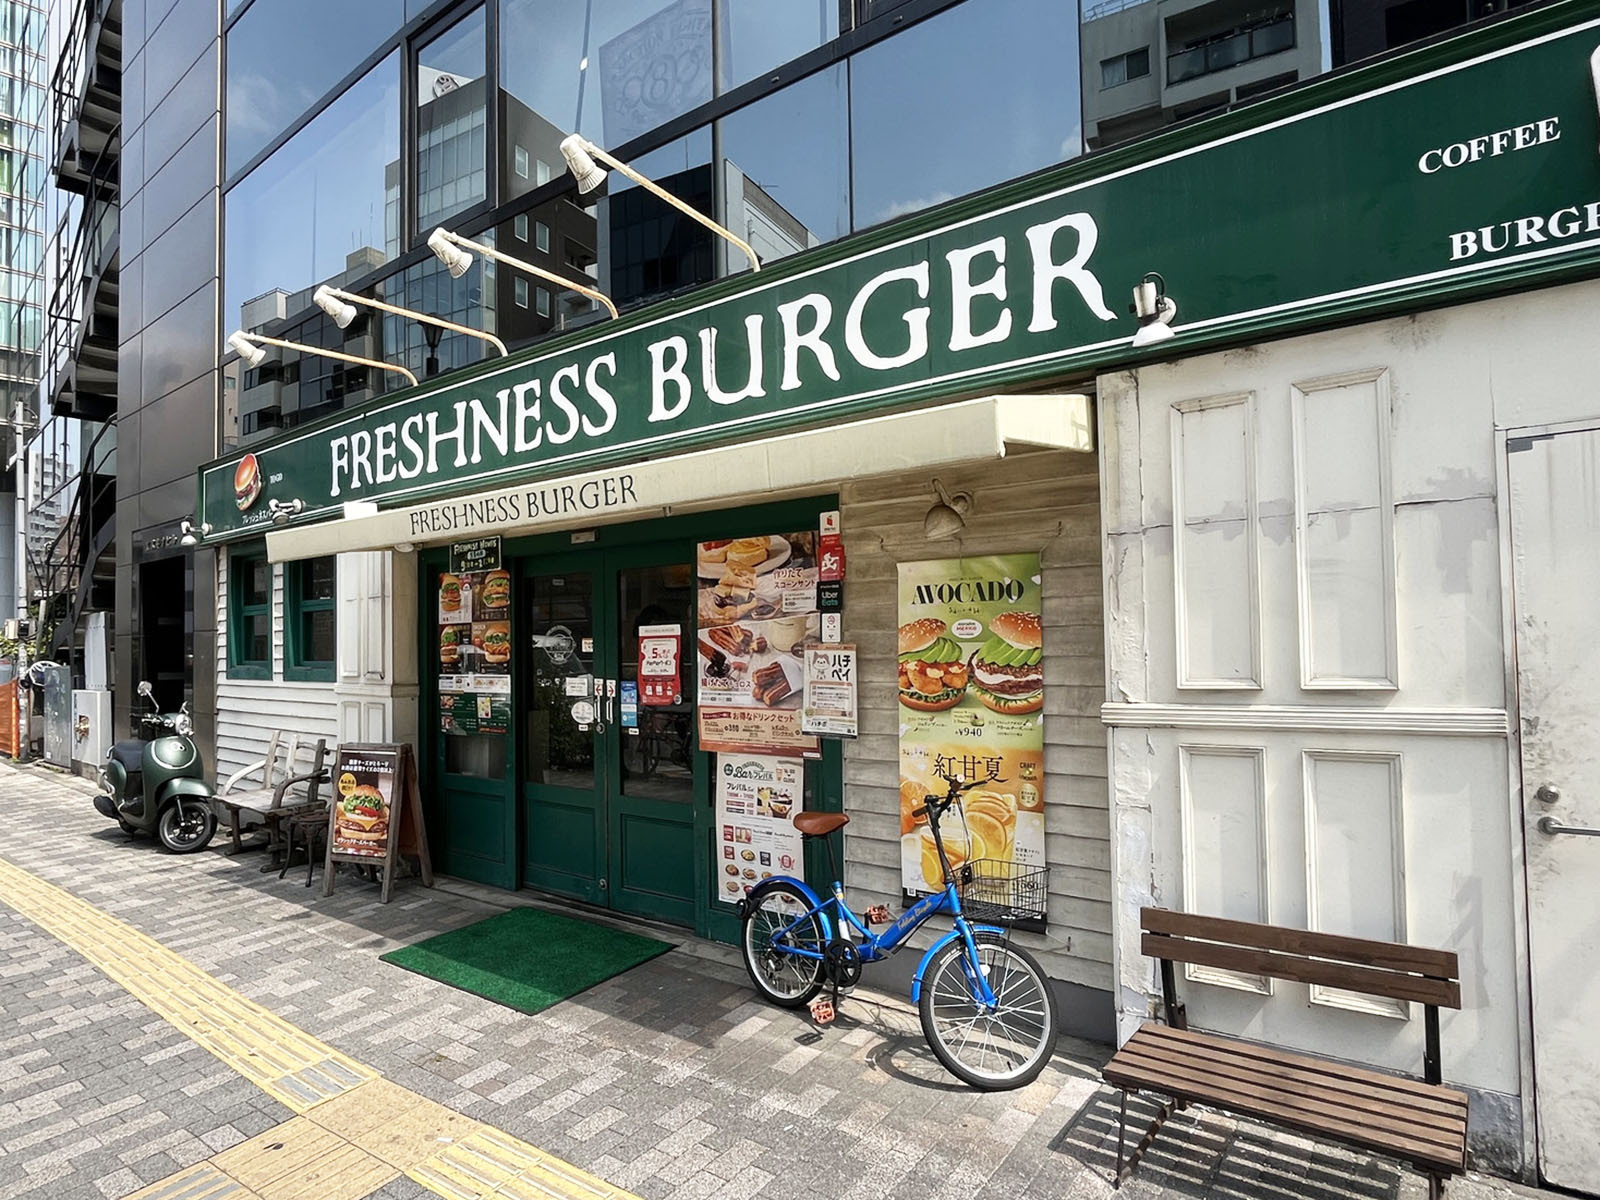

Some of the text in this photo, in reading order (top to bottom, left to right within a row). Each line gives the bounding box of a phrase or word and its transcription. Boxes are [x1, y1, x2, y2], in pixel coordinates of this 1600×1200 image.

[1418, 117, 1561, 173] COFFEE
[329, 211, 1118, 498] FRESHNESS BURGER
[410, 474, 638, 536] FRESHNESS BURGER
[912, 579, 1024, 604] AVOCADO
[832, 654, 851, 667] ハチ
[832, 668, 851, 681] ペイ
[733, 712, 795, 722] お得なドリンクセット
[733, 767, 753, 778] Bar
[931, 753, 1009, 783] 紅甘夏
